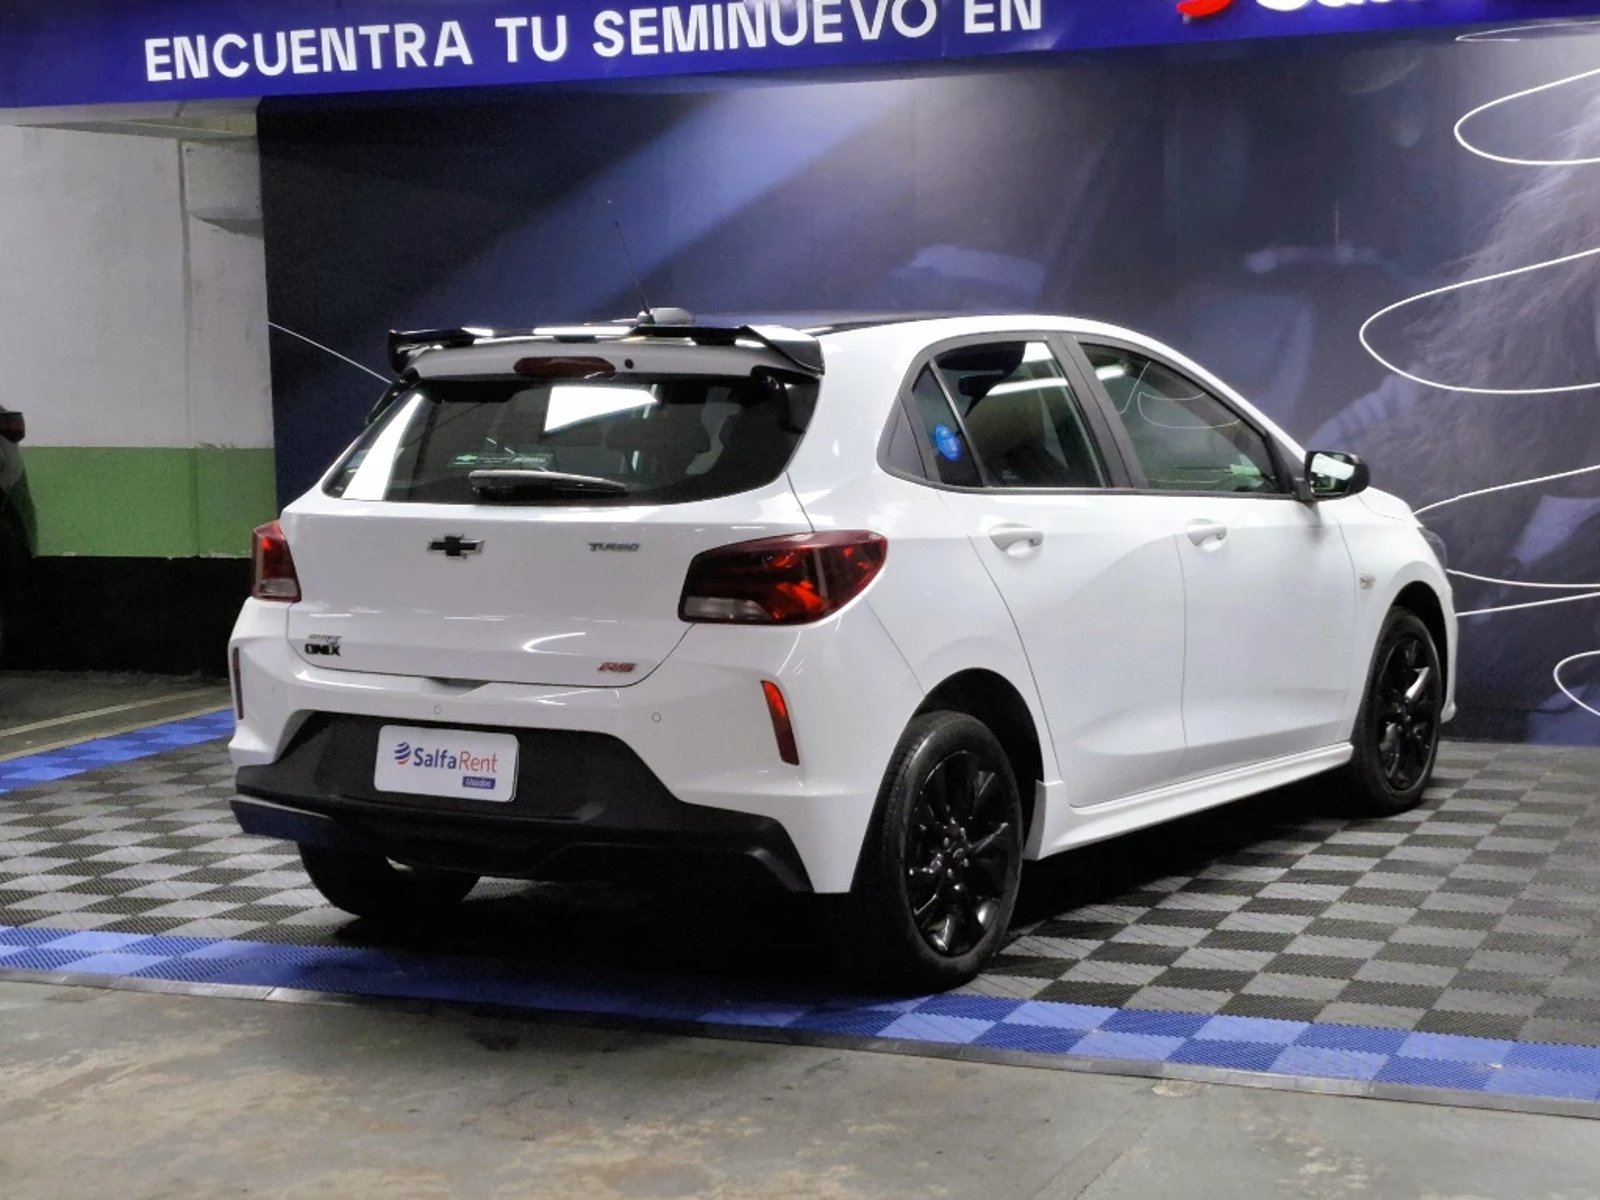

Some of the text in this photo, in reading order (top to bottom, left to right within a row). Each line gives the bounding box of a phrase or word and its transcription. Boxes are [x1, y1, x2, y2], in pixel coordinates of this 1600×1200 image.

[144, 0, 1042, 82] ENCUENTRA TU SEMINUEVO EN
[413, 747, 498, 773] SalfaRent
